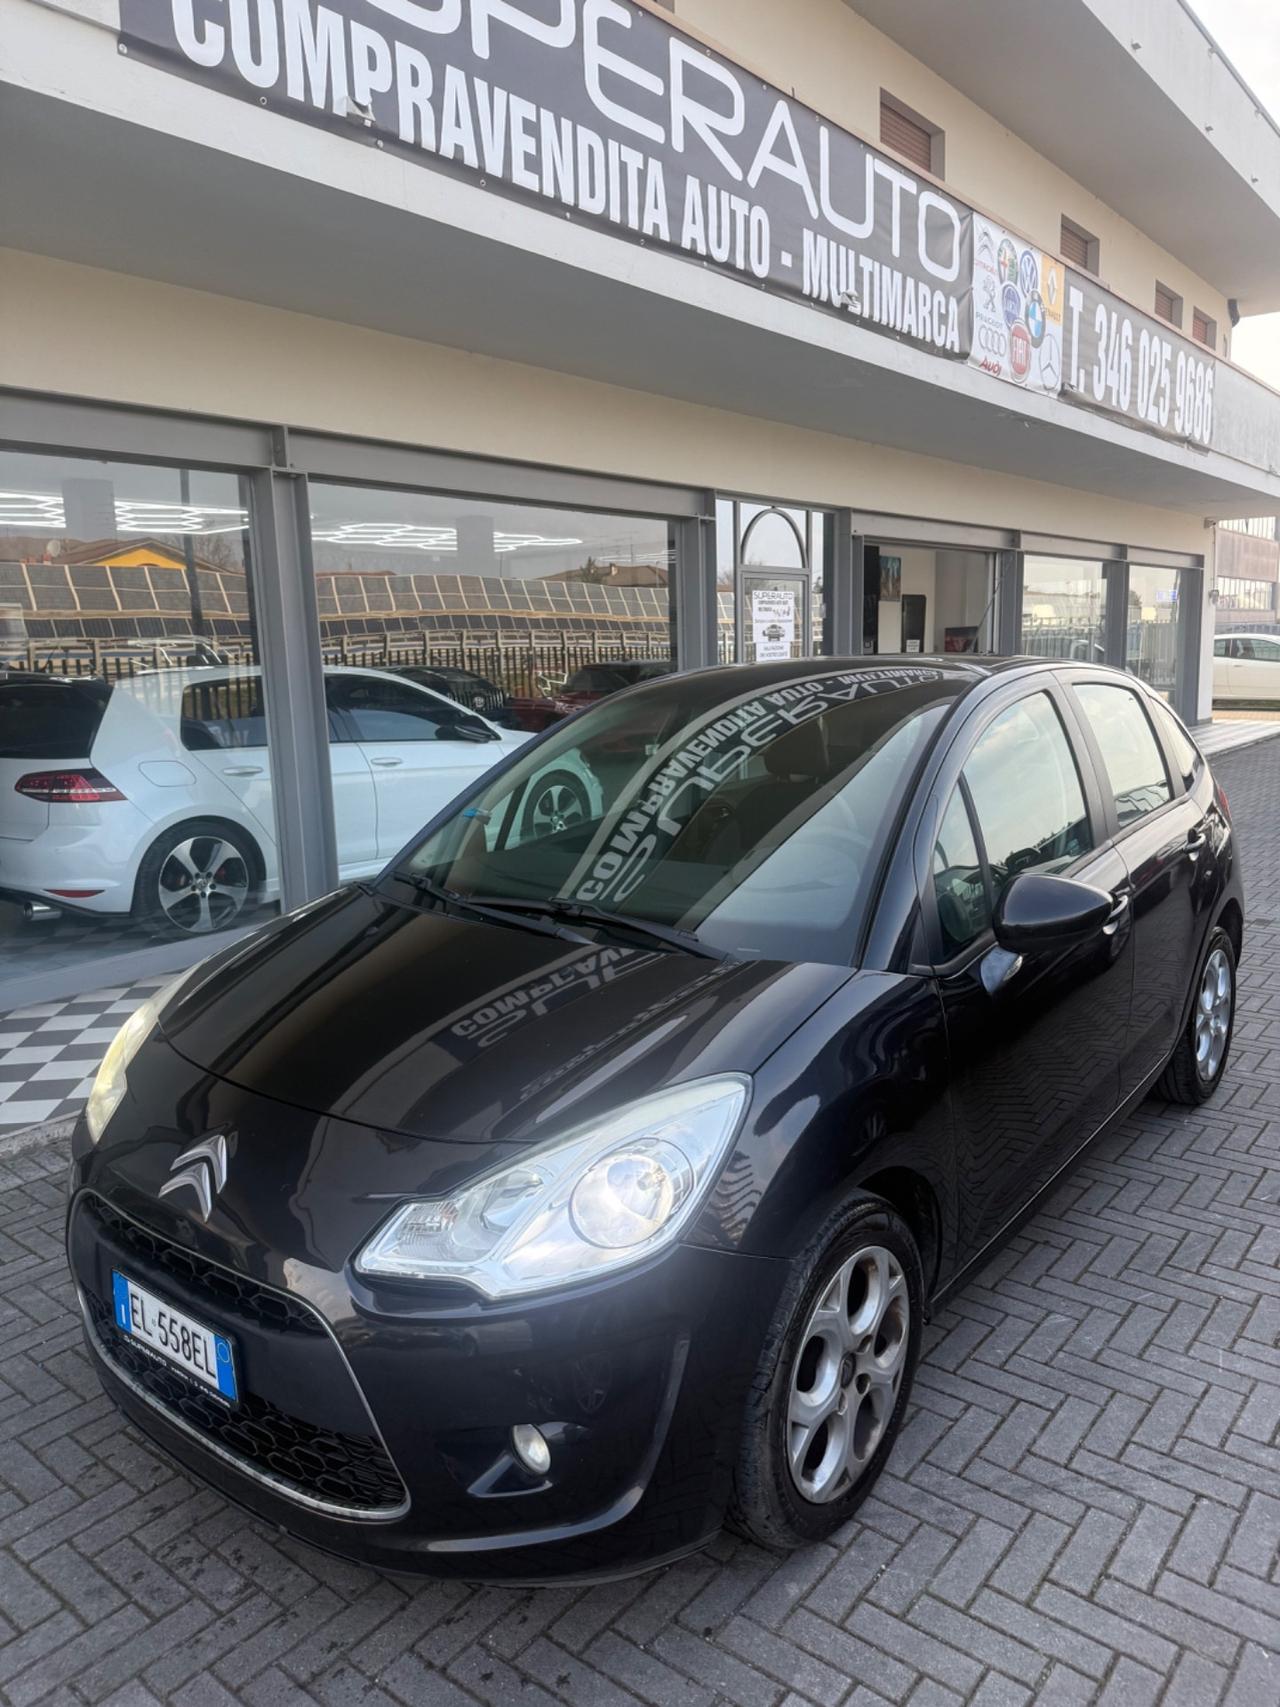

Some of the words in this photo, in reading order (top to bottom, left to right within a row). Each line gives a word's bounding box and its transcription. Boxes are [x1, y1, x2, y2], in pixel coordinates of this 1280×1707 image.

[171, 0, 671, 243] COMPRAVENDITA
[681, 174, 770, 279] AUTO
[801, 227, 960, 353] MULTIMARCA
[1093, 303, 1133, 412] 346
[1137, 328, 1172, 428] 025
[1174, 351, 1215, 444] 9686
[130, 1293, 153, 1338] EL
[157, 1310, 216, 1379] 558EL
